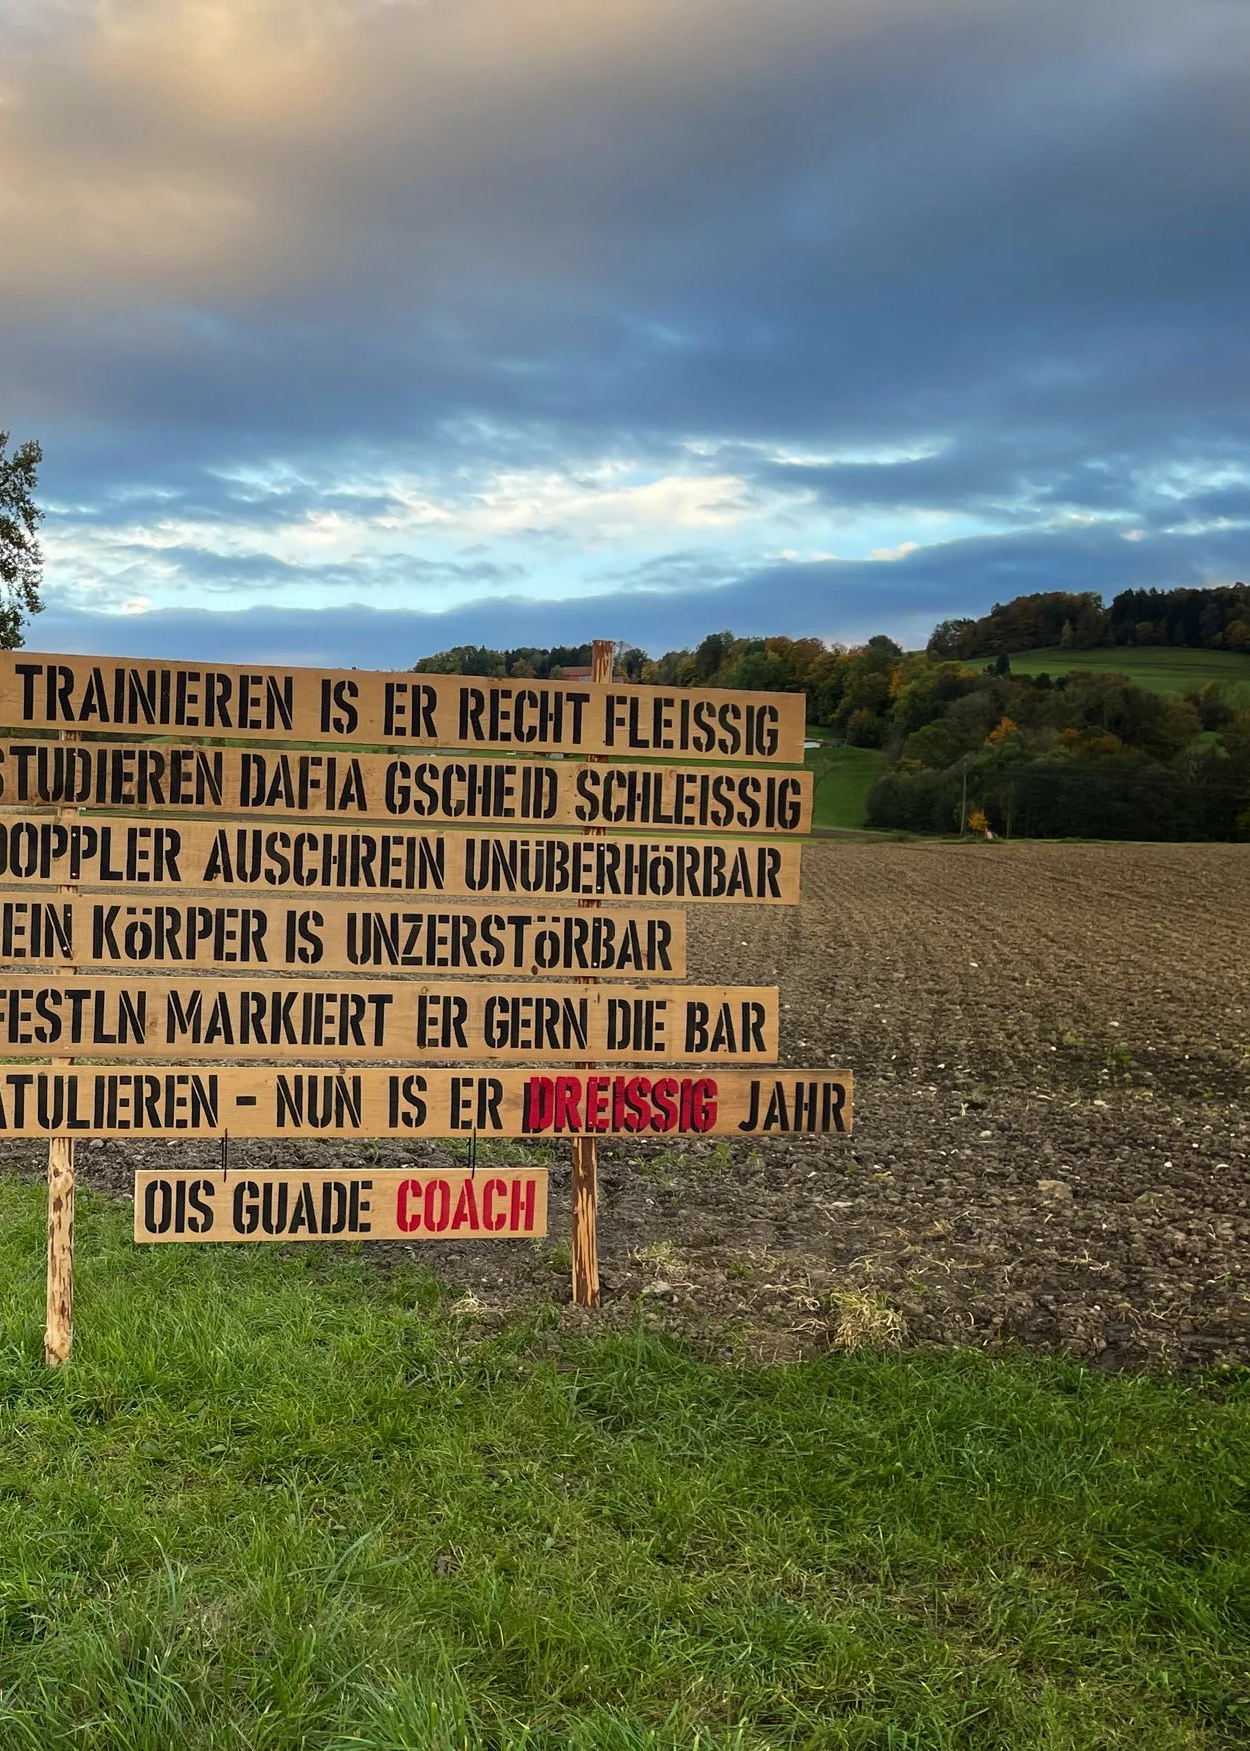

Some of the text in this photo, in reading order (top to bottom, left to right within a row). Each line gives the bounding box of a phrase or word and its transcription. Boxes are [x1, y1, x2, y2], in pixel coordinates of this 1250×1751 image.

[15, 664, 293, 730] TRAINIEREN
[321, 679, 358, 734] IS
[384, 683, 437, 737] ER
[459, 688, 590, 744] RECHT
[605, 695, 779, 757] FLEISSIG
[240, 753, 368, 810] DAFIA
[385, 760, 558, 818] GSCHEID
[575, 769, 802, 830] SCHLEISSIG
[203, 829, 445, 888] AUSCHREIN
[286, 911, 323, 963] IS
[167, 991, 393, 1046] MARKIERT
[417, 996, 467, 1049] ER
[485, 996, 587, 1049] GERN
[607, 999, 666, 1051] DIE
[685, 1002, 766, 1052] BAR
[277, 1075, 361, 1128] NUN
[389, 1075, 426, 1127] IS
[451, 1078, 502, 1129] ER
[522, 1076, 718, 1134] DREISSIG
[738, 1081, 846, 1133] JAHR
[145, 1178, 535, 1234] OIS GUADE COACH
